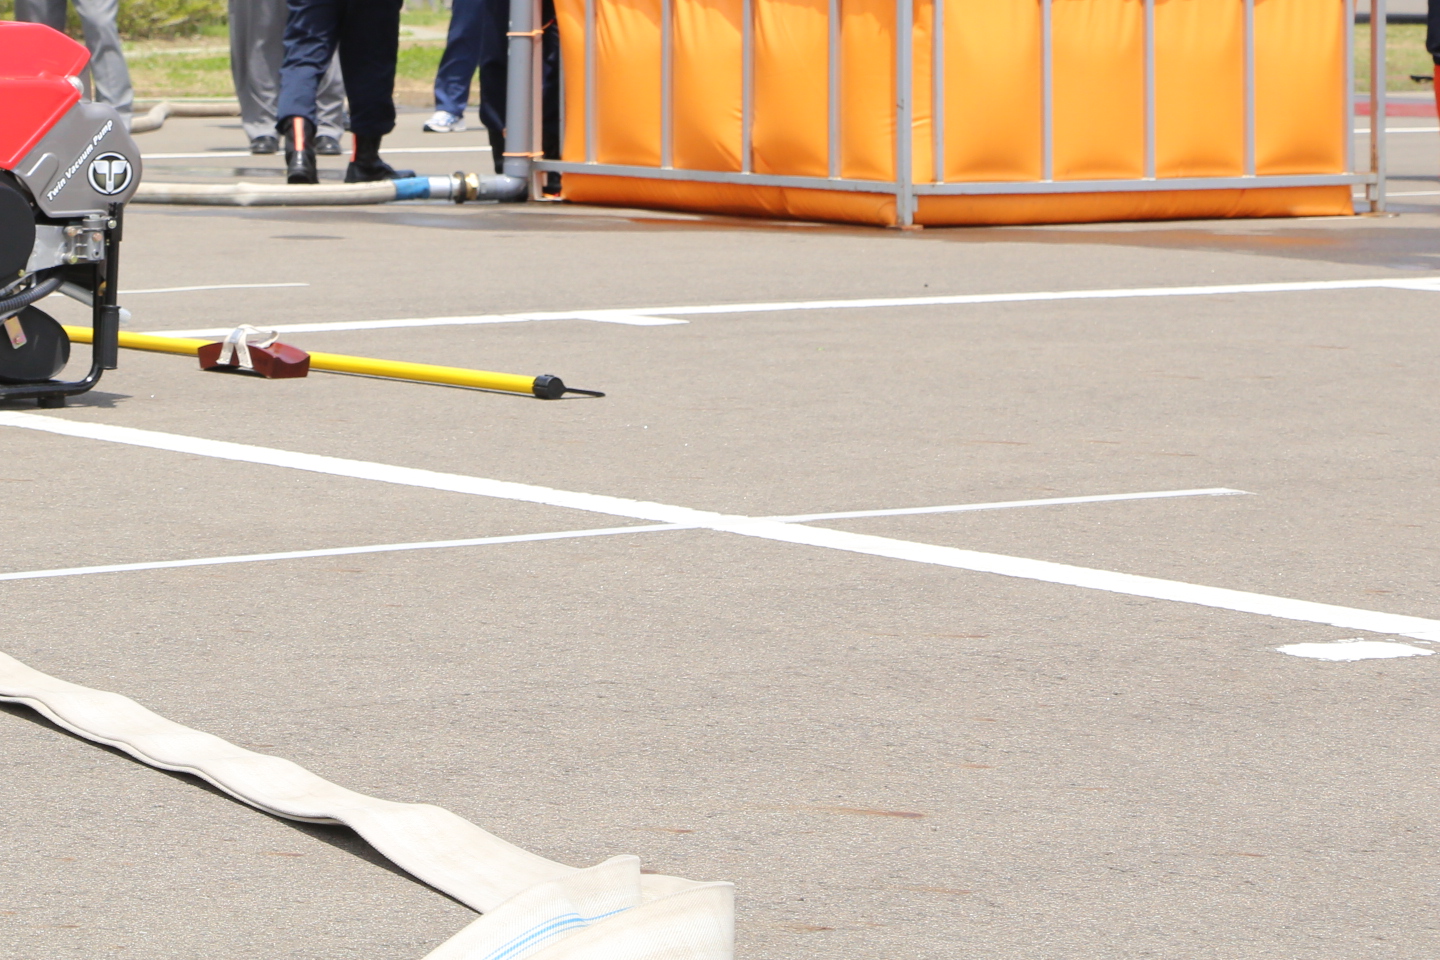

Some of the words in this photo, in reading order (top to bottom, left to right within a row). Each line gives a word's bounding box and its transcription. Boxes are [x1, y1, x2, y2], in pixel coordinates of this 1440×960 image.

[46, 178, 67, 201] Twin
[65, 143, 94, 179] Vacuum
[92, 120, 113, 146] Pump
